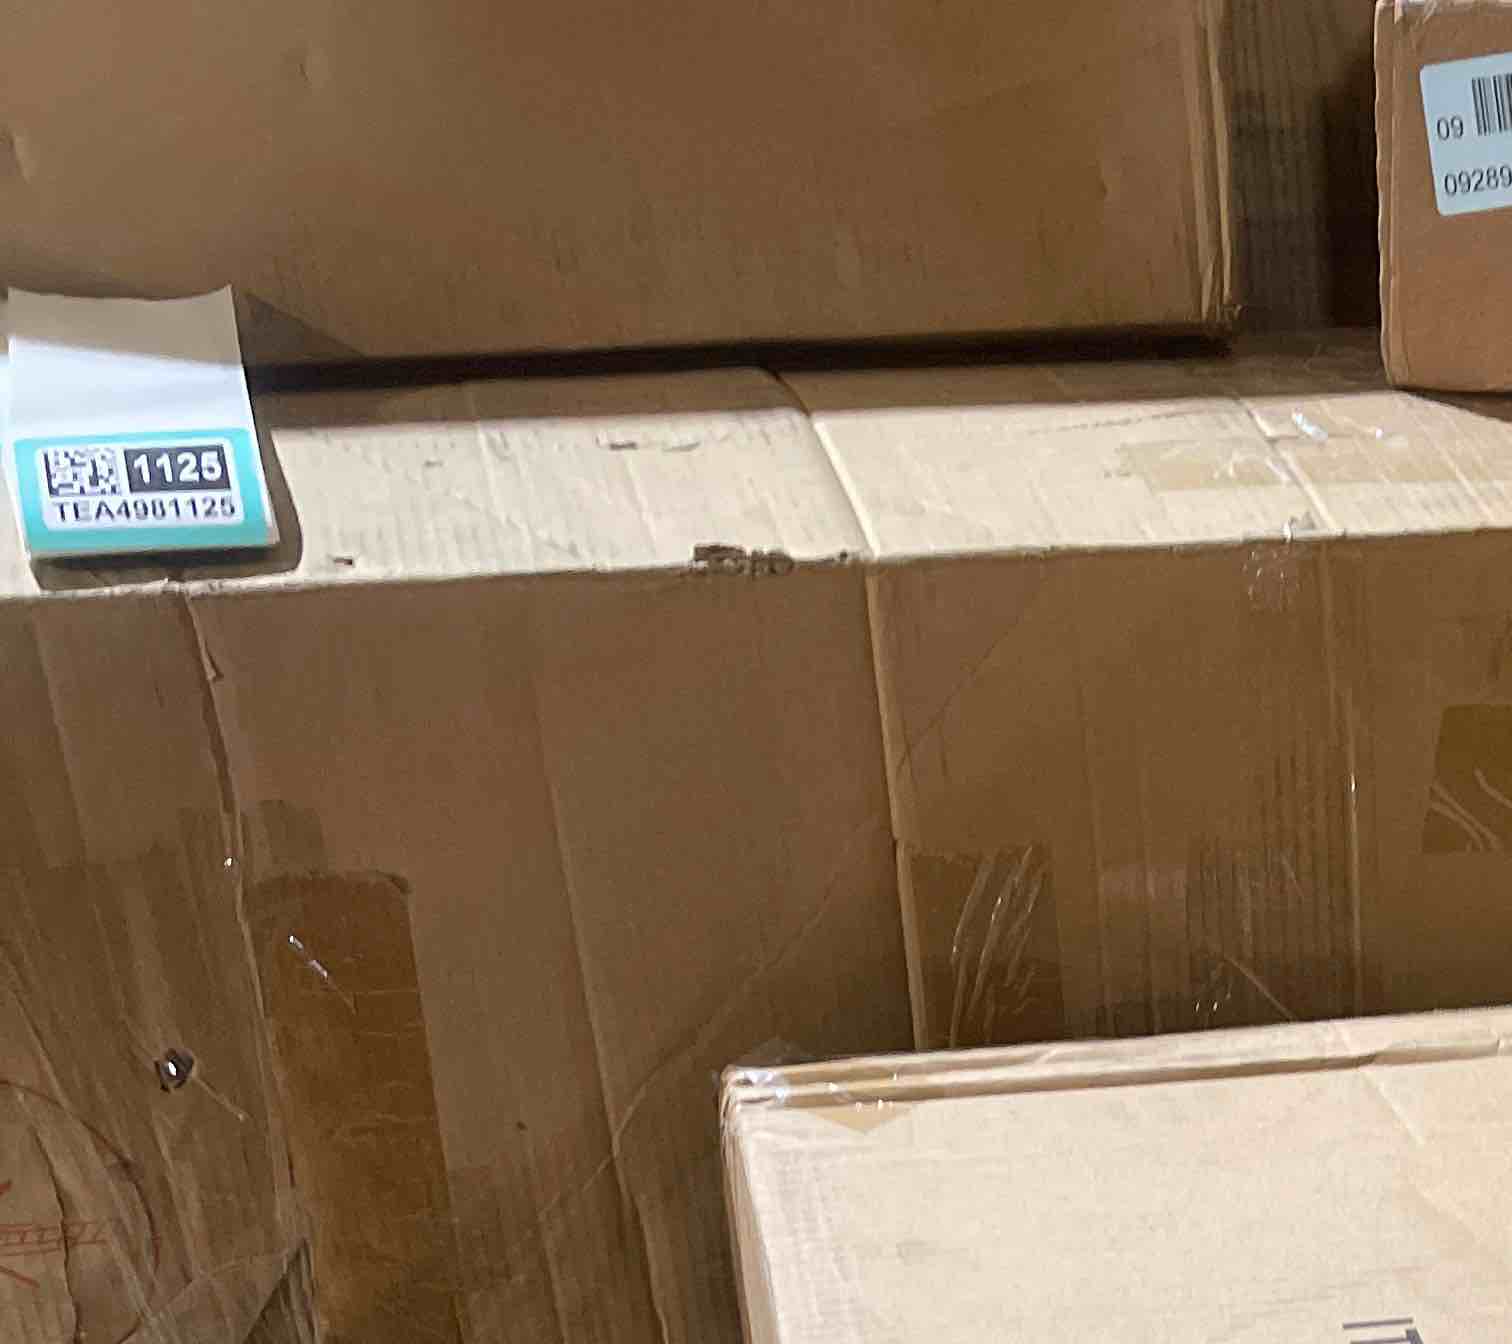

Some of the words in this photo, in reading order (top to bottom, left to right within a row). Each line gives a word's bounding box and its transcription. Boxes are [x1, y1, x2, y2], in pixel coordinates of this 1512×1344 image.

[1435, 115, 1464, 141] 09
[133, 450, 222, 484] 1125
[53, 494, 236, 523] TEA4981125
